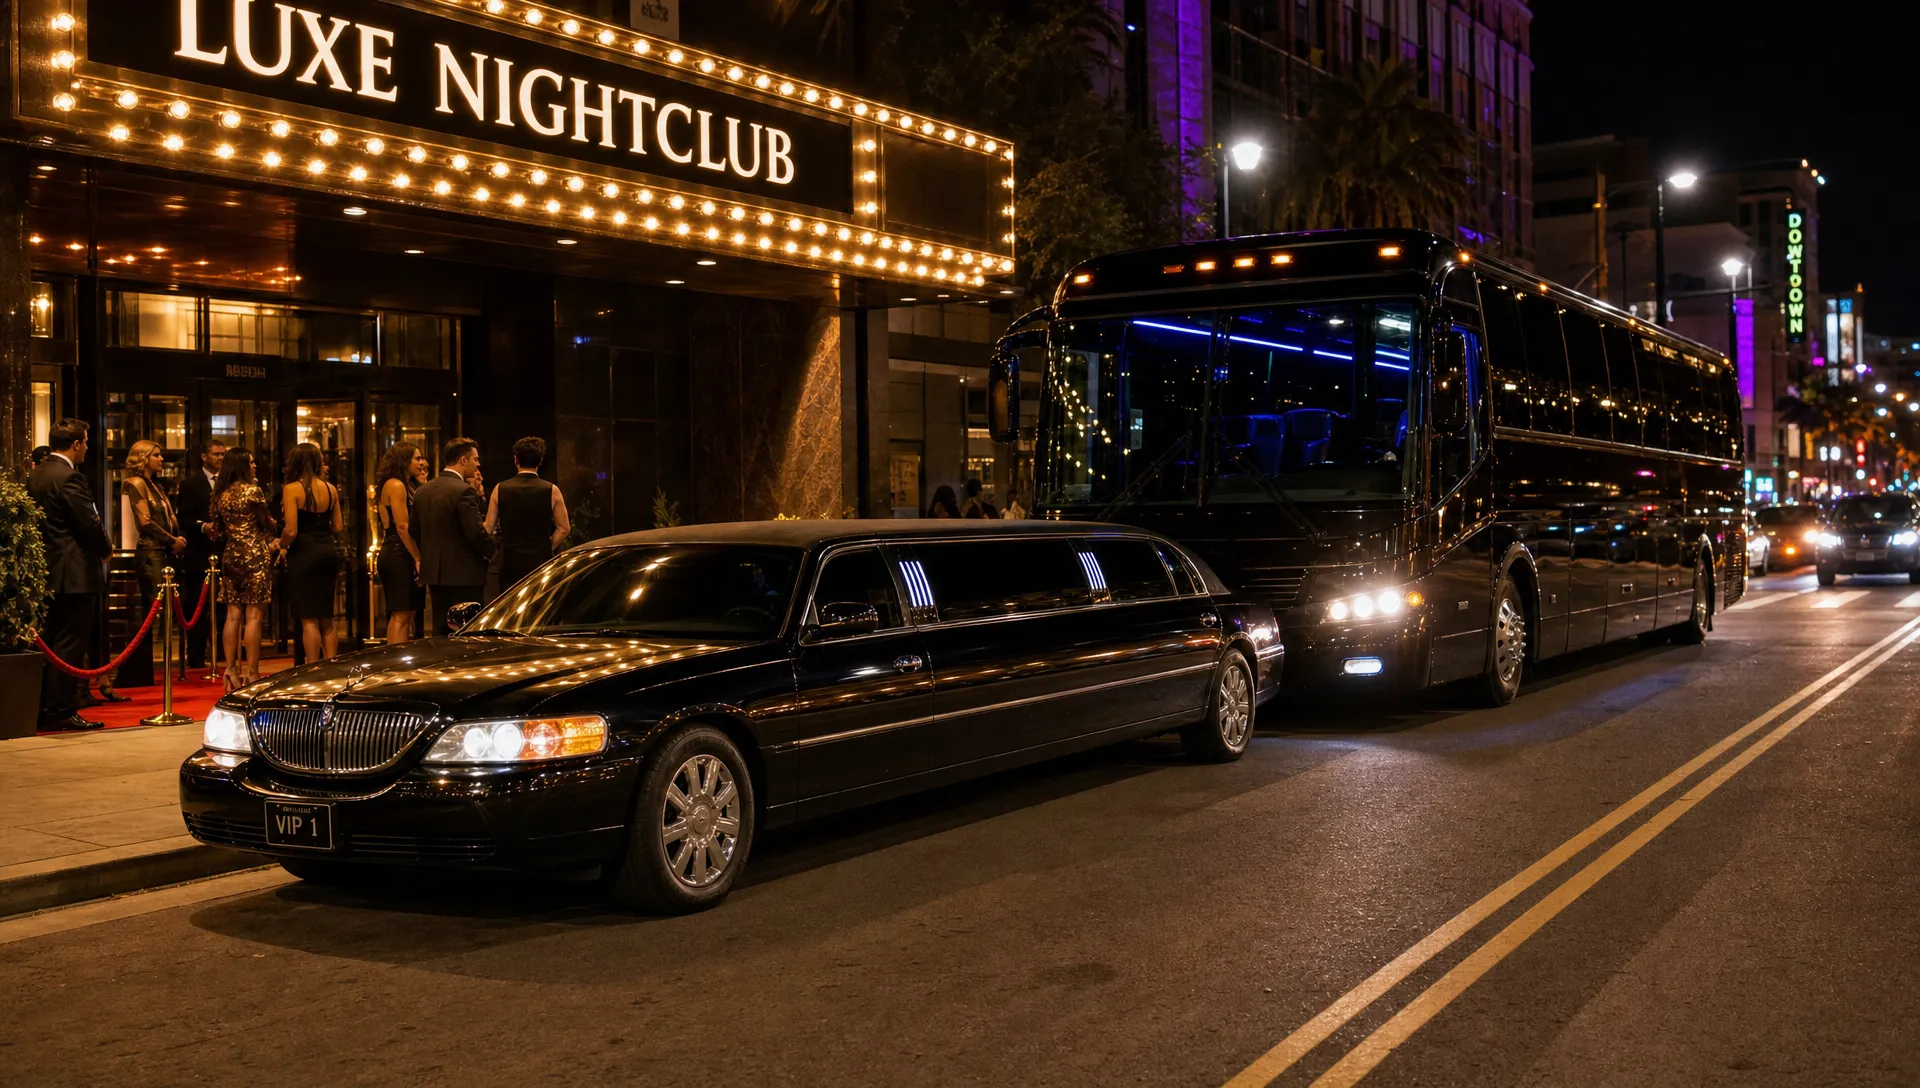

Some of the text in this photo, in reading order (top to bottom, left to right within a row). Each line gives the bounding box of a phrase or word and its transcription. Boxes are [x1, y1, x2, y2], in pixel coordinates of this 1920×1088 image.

[174, 0, 795, 185] LUXE NIGHTCLUB
[275, 815, 318, 837] VIP 1
